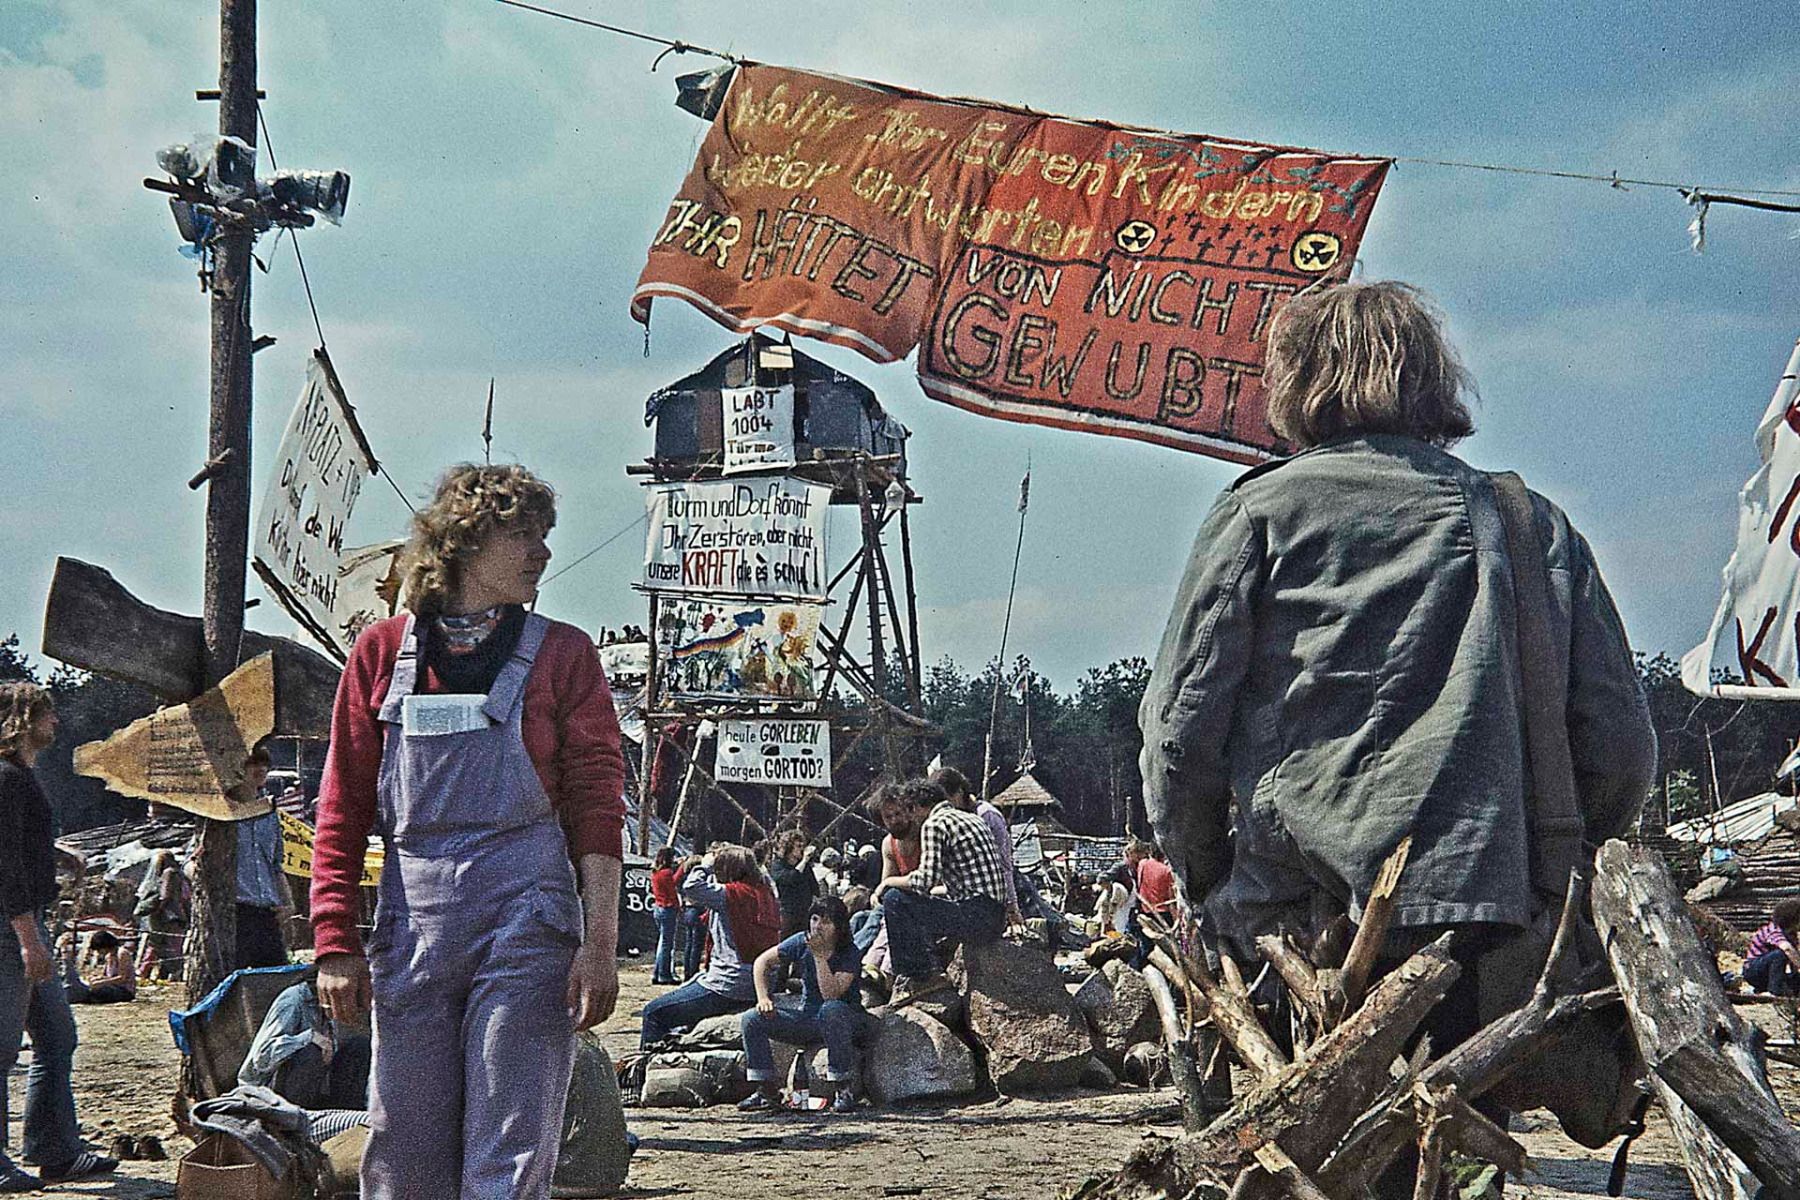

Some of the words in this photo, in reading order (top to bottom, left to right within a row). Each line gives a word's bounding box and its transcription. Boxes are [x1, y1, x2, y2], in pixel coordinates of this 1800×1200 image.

[953, 120, 1107, 195] Euren
[1111, 152, 1323, 222] Kindern
[653, 199, 742, 269] IHR
[967, 250, 1062, 307] VON
[1084, 266, 1326, 342] NICHT
[731, 415, 773, 436] 1004
[657, 488, 708, 518] Turm
[711, 485, 736, 518] und
[736, 482, 779, 520] Dorf
[788, 526, 814, 549] nicht
[649, 561, 680, 581] unsere
[682, 549, 739, 588] KRAFT
[737, 550, 752, 582] die
[311, 574, 337, 613] nicht
[725, 724, 757, 743] heute
[760, 723, 822, 744] GORLEBEN
[720, 766, 762, 780] morgen
[764, 757, 824, 779] GORTOD?
